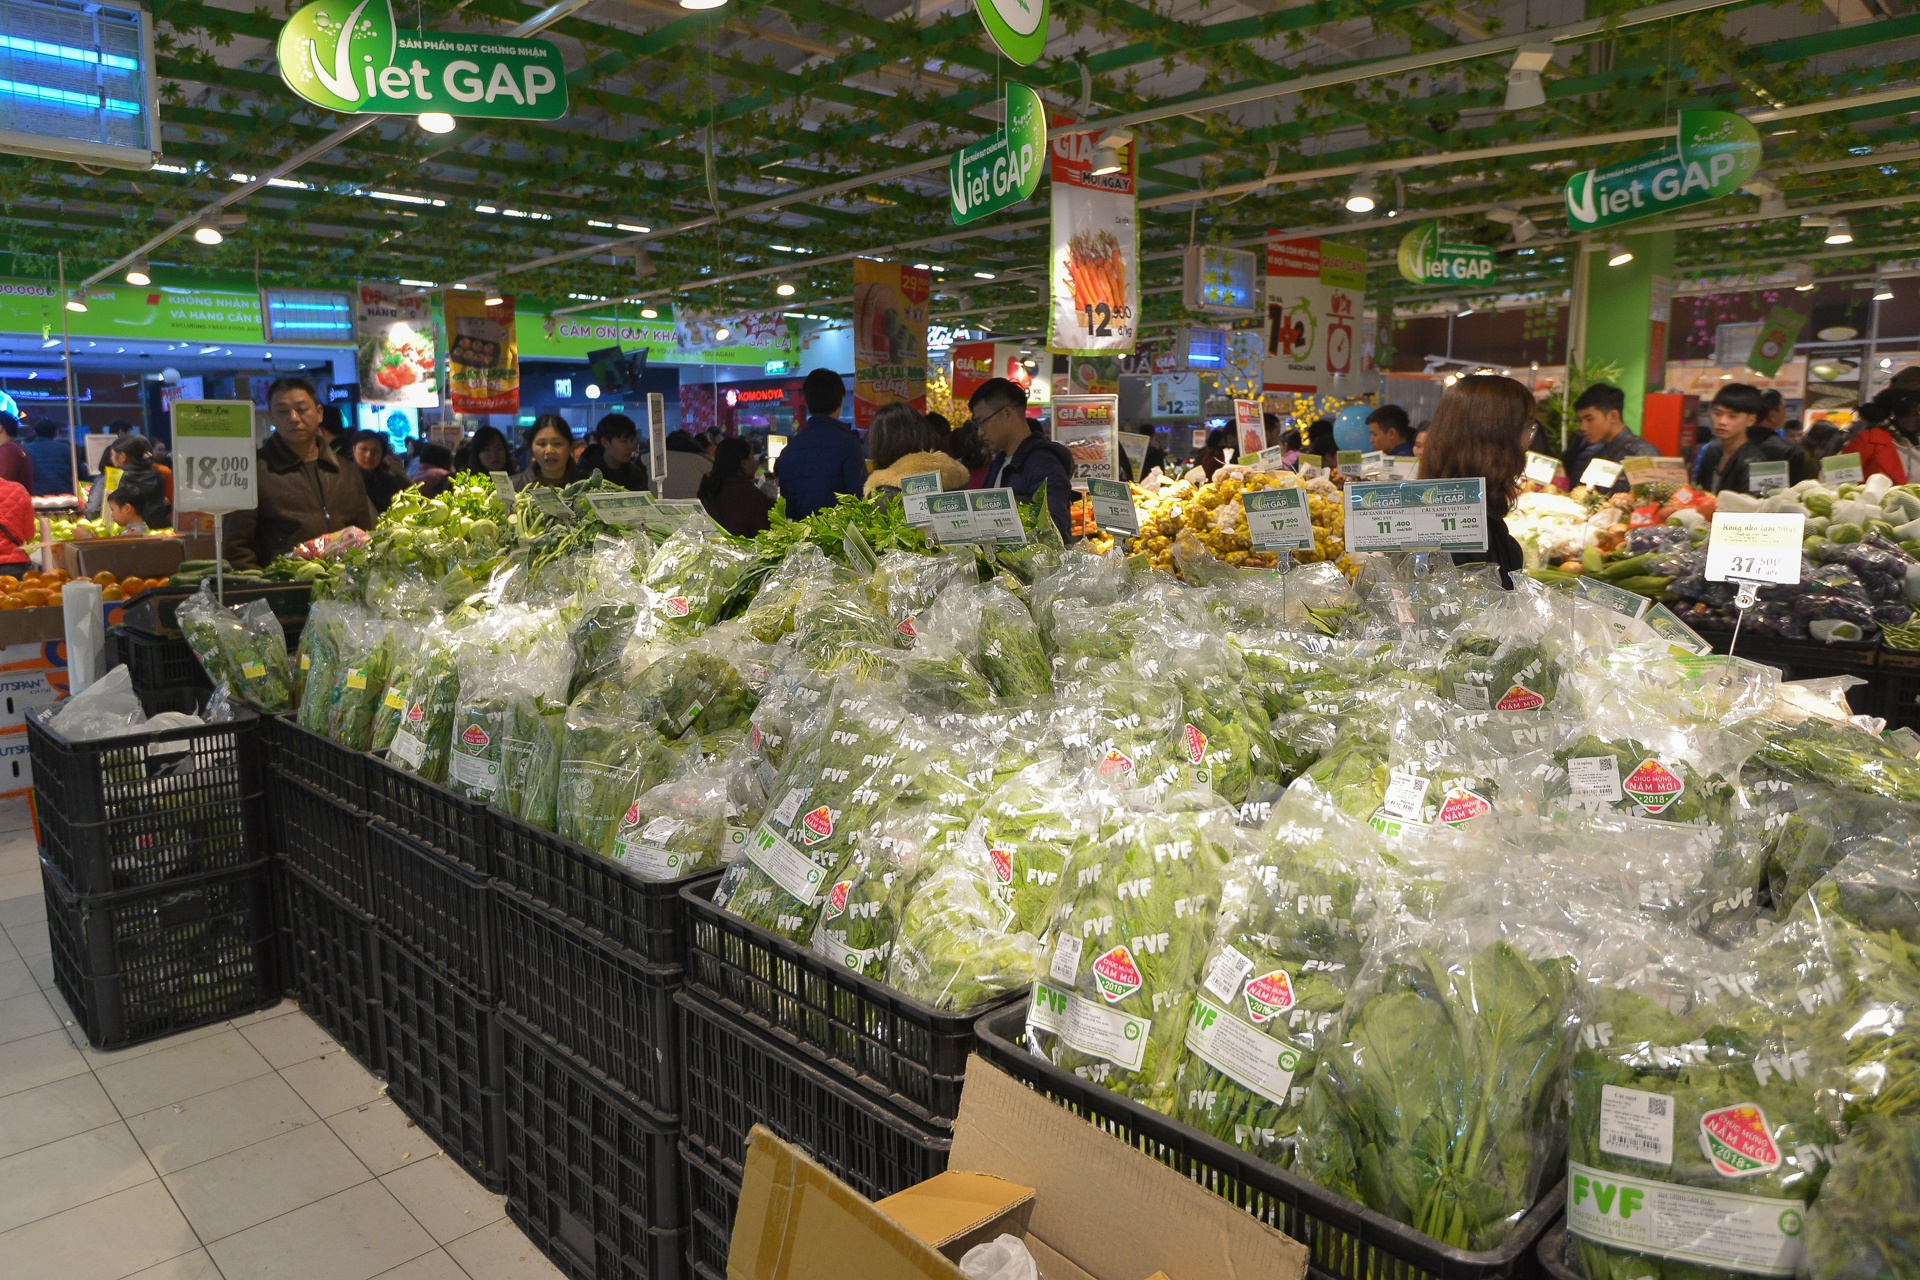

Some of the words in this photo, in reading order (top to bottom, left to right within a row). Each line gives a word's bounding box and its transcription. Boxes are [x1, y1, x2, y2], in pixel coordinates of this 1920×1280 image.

[309, 0, 433, 102] Viet
[443, 60, 556, 105] GAP
[399, 37, 422, 50] SẢN
[424, 39, 455, 52] PHẨM
[456, 42, 479, 54] ĐẠT
[481, 44, 516, 56] CHỨNG
[518, 47, 547, 58] NHẬN
[950, 149, 990, 215] Viet
[993, 143, 1033, 197] GAP
[1568, 169, 1645, 224] Viet
[1652, 153, 1735, 201] GAP
[1408, 226, 1450, 280] Viet
[1452, 257, 1493, 280] GAP
[903, 275, 916, 290] 29
[169, 296, 212, 307] KHÔNG
[216, 297, 248, 310] NHẬN
[171, 309, 187, 319] VÀ
[190, 308, 225, 322] HÀNG
[1085, 302, 1112, 337] 12
[559, 320, 591, 338] CẢM
[596, 322, 617, 339] ƠN
[620, 326, 650, 342] QUÝ
[653, 327, 678, 342] KHÁ
[775, 338, 793, 350] LẠI
[956, 357, 975, 371] GIÁ
[738, 389, 784, 401] KOMONOYA
[1058, 407, 1086, 420] GIÁ
[1087, 405, 1109, 420] RẺ
[1167, 401, 1184, 414] 12
[186, 456, 217, 490] 18
[919, 501, 928, 511] 20
[989, 501, 1000, 509] GAP
[1270, 500, 1287, 508] GAP
[1381, 499, 1400, 508] GAP
[1443, 494, 1464, 504] GAP
[1109, 506, 1120, 517] 15
[951, 520, 960, 530] 11
[993, 519, 1003, 528] 11
[1271, 520, 1285, 531] 17
[1377, 521, 1391, 533] 11
[1441, 518, 1456, 531] 11
[1731, 556, 1755, 573] 37
[1289, 660, 1319, 674] FVF
[1512, 659, 1543, 686] FVF
[796, 688, 820, 702] FVF
[840, 699, 868, 713] FVF
[1500, 702, 1522, 711] NĂM
[1524, 698, 1541, 710] MỚI
[869, 717, 898, 732] FVF
[1454, 714, 1489, 732] FVF
[831, 730, 859, 745] FVF
[902, 737, 927, 752] FVF
[1512, 727, 1549, 745] FVF
[821, 768, 849, 783] FVF
[967, 768, 993, 785] FVF
[1633, 774, 1651, 782] CHÚC
[1652, 774, 1672, 782] MỪNG
[1630, 781, 1653, 791] NĂM
[1657, 781, 1677, 791] MỚI
[852, 789, 879, 805] FVF
[1445, 804, 1461, 813] CHÚC
[1461, 799, 1479, 810] MỪNG
[1444, 811, 1468, 823] NĂM
[806, 817, 818, 829] NĂM
[818, 824, 829, 835] MỚI
[755, 826, 776, 851] FVF
[1155, 840, 1192, 862] FVF
[1027, 869, 1057, 886] FVF
[1078, 863, 1102, 887] FVF
[1118, 878, 1152, 900] FVF
[1175, 894, 1206, 918] FVF
[1298, 895, 1332, 914] FVF
[1712, 887, 1753, 912] FVF
[849, 901, 880, 919] FVF
[1083, 915, 1113, 937] FVF
[864, 941, 890, 964] FVF
[1131, 933, 1170, 956] FVF
[1097, 963, 1118, 979] NĂM
[1118, 969, 1138, 984] MỚI
[1103, 957, 1119, 969] CHÚC
[1119, 962, 1134, 975] MỪNG
[1104, 980, 1122, 993] 2018
[1250, 985, 1270, 999] NĂM
[1270, 992, 1289, 1005] MỚI
[1256, 980, 1271, 990] CHÚC
[1271, 985, 1288, 997] MỪNG
[1037, 985, 1067, 1015] FVF
[1289, 1010, 1331, 1031] FVF
[1752, 1050, 1811, 1087] FVF
[1188, 1090, 1217, 1110] FVF
[1235, 1124, 1275, 1148] FVF
[1718, 1112, 1741, 1133] CHÚC
[1741, 1126, 1768, 1148] MỪNG
[1708, 1118, 1738, 1145] NĂM
[1742, 1140, 1773, 1162] MỚI
[1717, 1145, 1743, 1168] 2018
[1573, 1173, 1645, 1219] FVF
[1615, 1229, 1646, 1242] Quality
